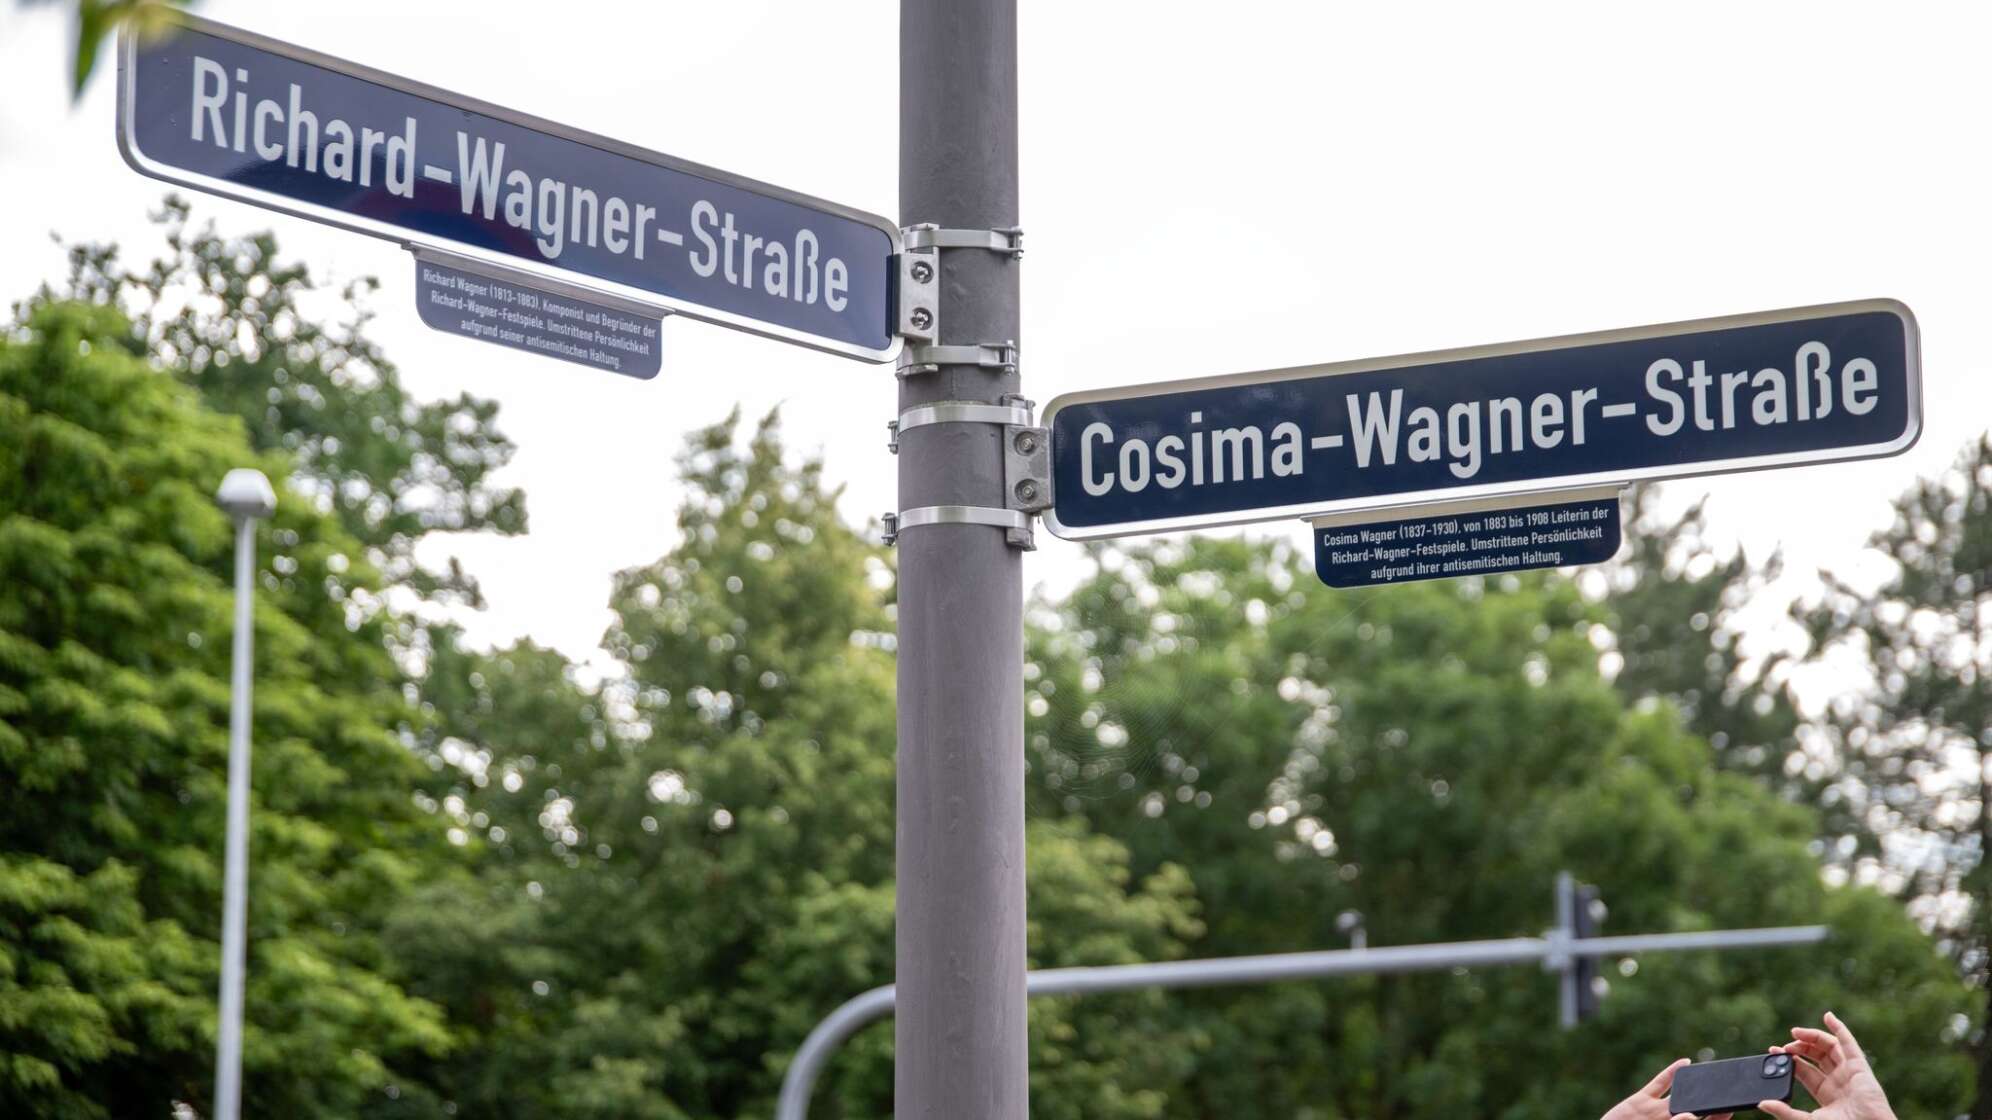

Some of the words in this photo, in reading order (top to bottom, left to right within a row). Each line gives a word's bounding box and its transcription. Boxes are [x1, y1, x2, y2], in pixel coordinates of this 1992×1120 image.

[190, 55, 849, 313] Richard-Wagner-Straße
[423, 268, 456, 288] Richard
[457, 277, 488, 297] Wagner
[542, 299, 584, 321] Komponist
[585, 312, 600, 324] und
[602, 313, 641, 334] Begründer
[643, 324, 657, 338] der
[431, 290, 546, 330] Richard-Wagner-Festspiele.
[547, 319, 594, 342] Umstrittene
[594, 330, 649, 355] Persönlichkeit
[460, 319, 498, 337] aufgrund
[499, 328, 525, 343] seiner
[526, 335, 588, 360] antisemitischen
[589, 348, 622, 370] Haltung.
[1079, 340, 1880, 497] Cosima-Wagner-Straße
[1324, 532, 1358, 546] Cosima
[1360, 530, 1397, 545] Wagner
[1399, 519, 1461, 540] (1837-1930),
[1463, 522, 1481, 532] von
[1483, 516, 1507, 531] 1883
[1509, 514, 1524, 528] bis
[1526, 511, 1549, 526] 1908
[1551, 508, 1589, 524] Leiterin
[1592, 506, 1609, 519] der
[1331, 540, 1469, 565] Richard-Wagner-Festspiele.
[1471, 535, 1529, 551] Umstrittene
[1531, 525, 1602, 545] Persönlichkeit
[1370, 562, 1414, 581] aufgrund
[1416, 562, 1441, 575] ihrer
[1443, 555, 1520, 573] antisemitischen
[1522, 550, 1563, 565] Haltung.
